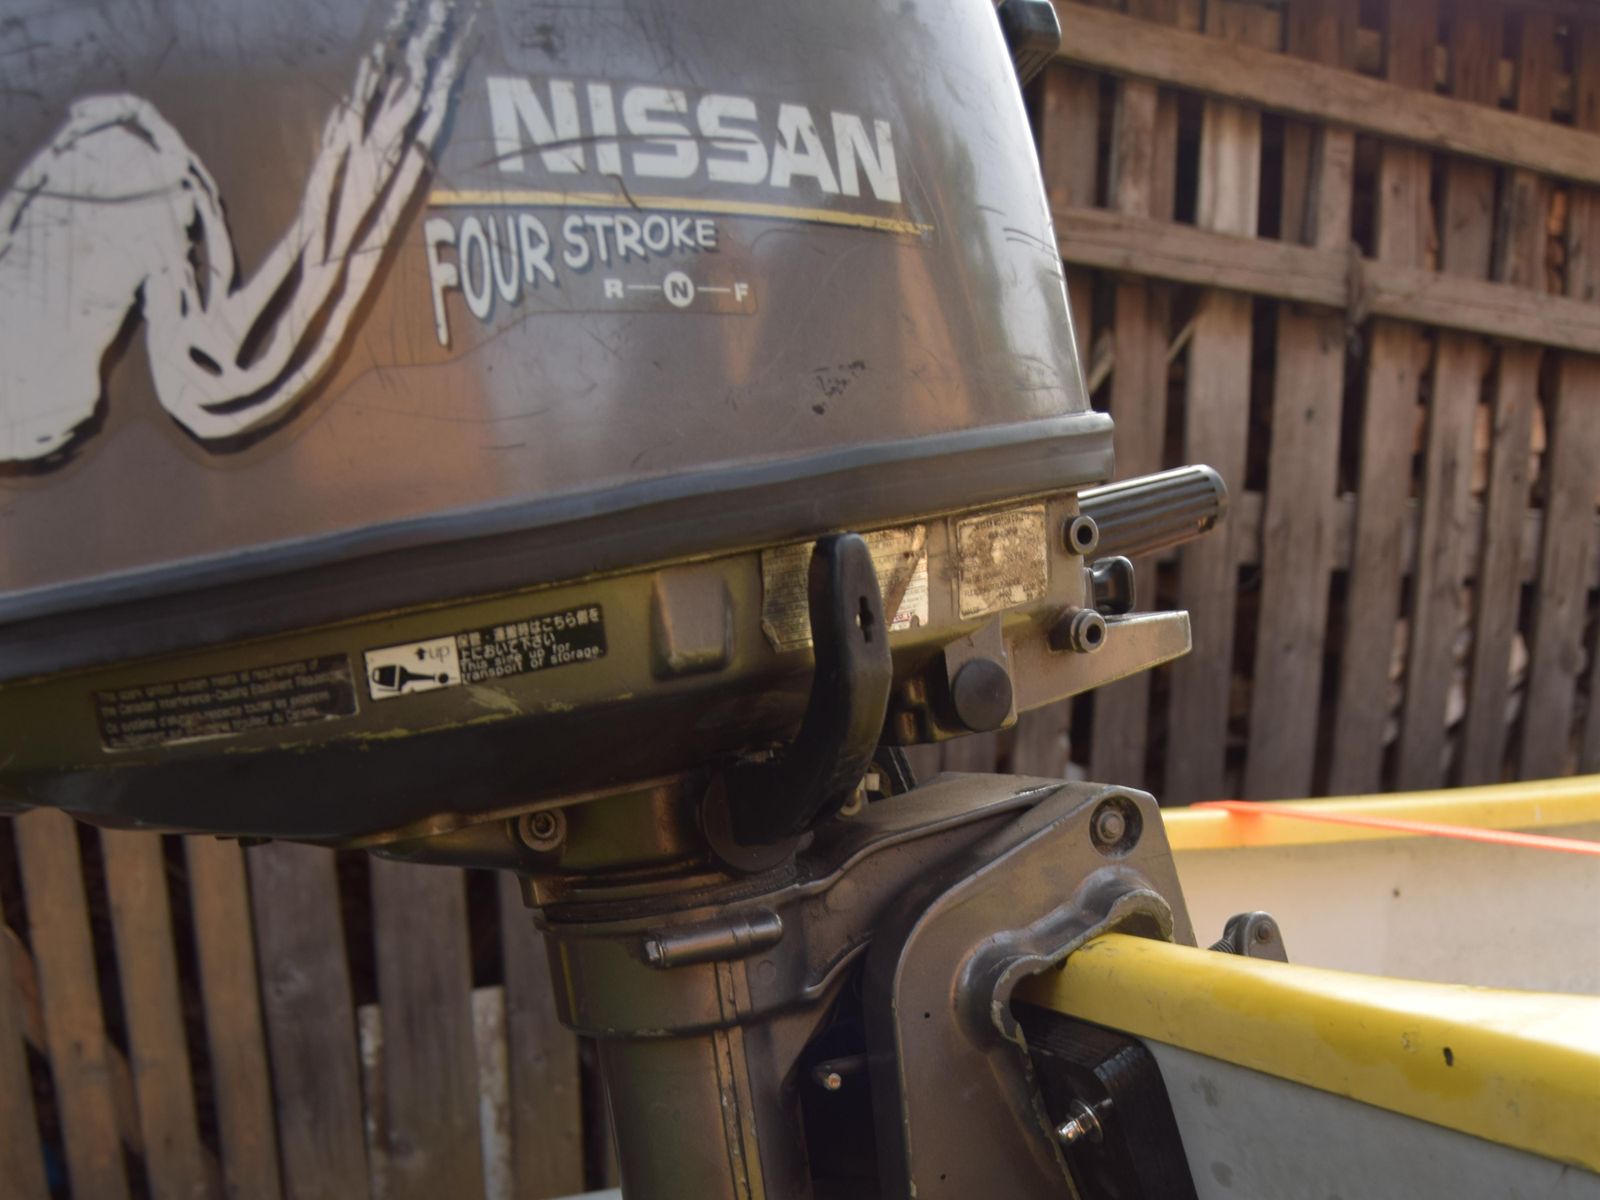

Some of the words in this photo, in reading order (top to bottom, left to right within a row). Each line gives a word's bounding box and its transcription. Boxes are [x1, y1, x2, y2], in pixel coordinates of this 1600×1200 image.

[487, 77, 901, 203] NISSAN
[424, 214, 557, 347] FOUR
[562, 214, 718, 269] STROKE
[605, 279, 624, 299] R
[735, 283, 749, 302] F
[428, 645, 450, 664] up
[461, 657, 488, 672] This
[529, 648, 545, 660] up
[552, 642, 570, 655] for
